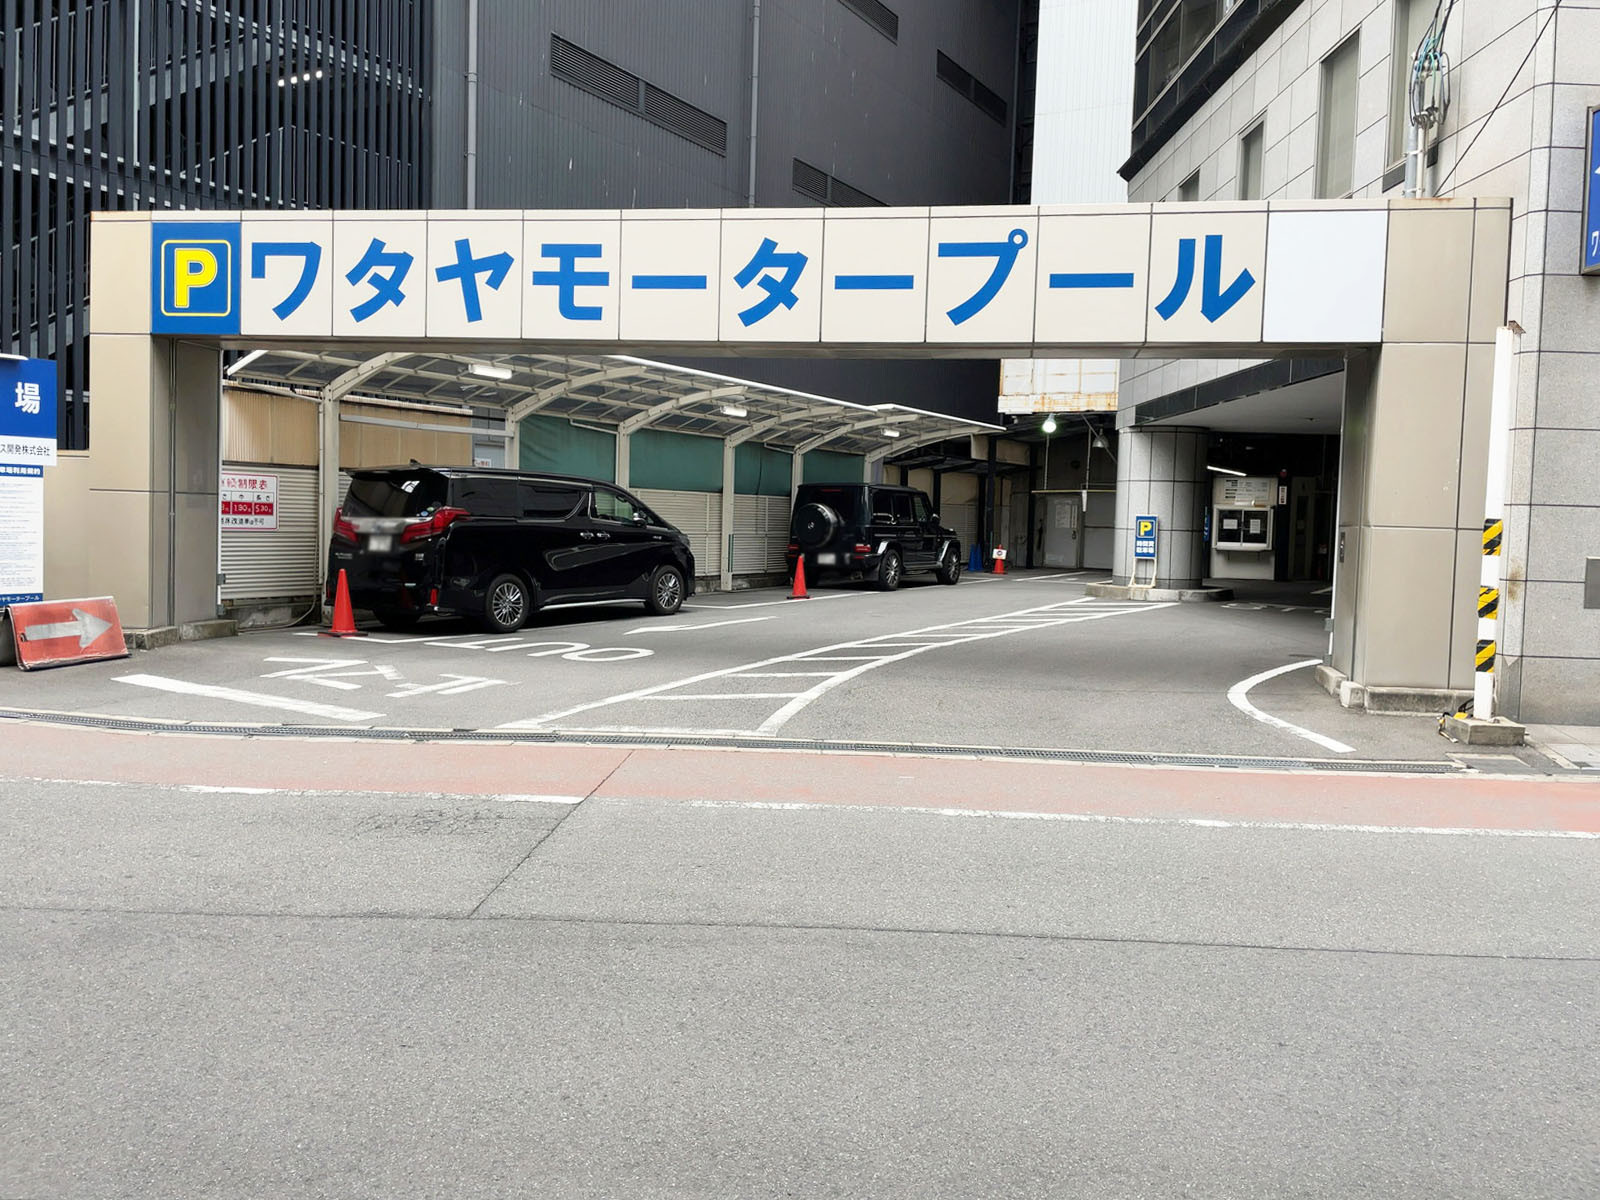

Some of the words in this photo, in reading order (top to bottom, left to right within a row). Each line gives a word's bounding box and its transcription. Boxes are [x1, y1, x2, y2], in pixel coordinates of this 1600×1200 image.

[174, 247, 218, 309] P
[252, 229, 1255, 326] ワタヤモータープール
[14, 382, 41, 414] 場
[0, 443, 51, 457] ス開発株式会社
[1139, 521, 1152, 536] P
[424, 637, 655, 662] OUT
